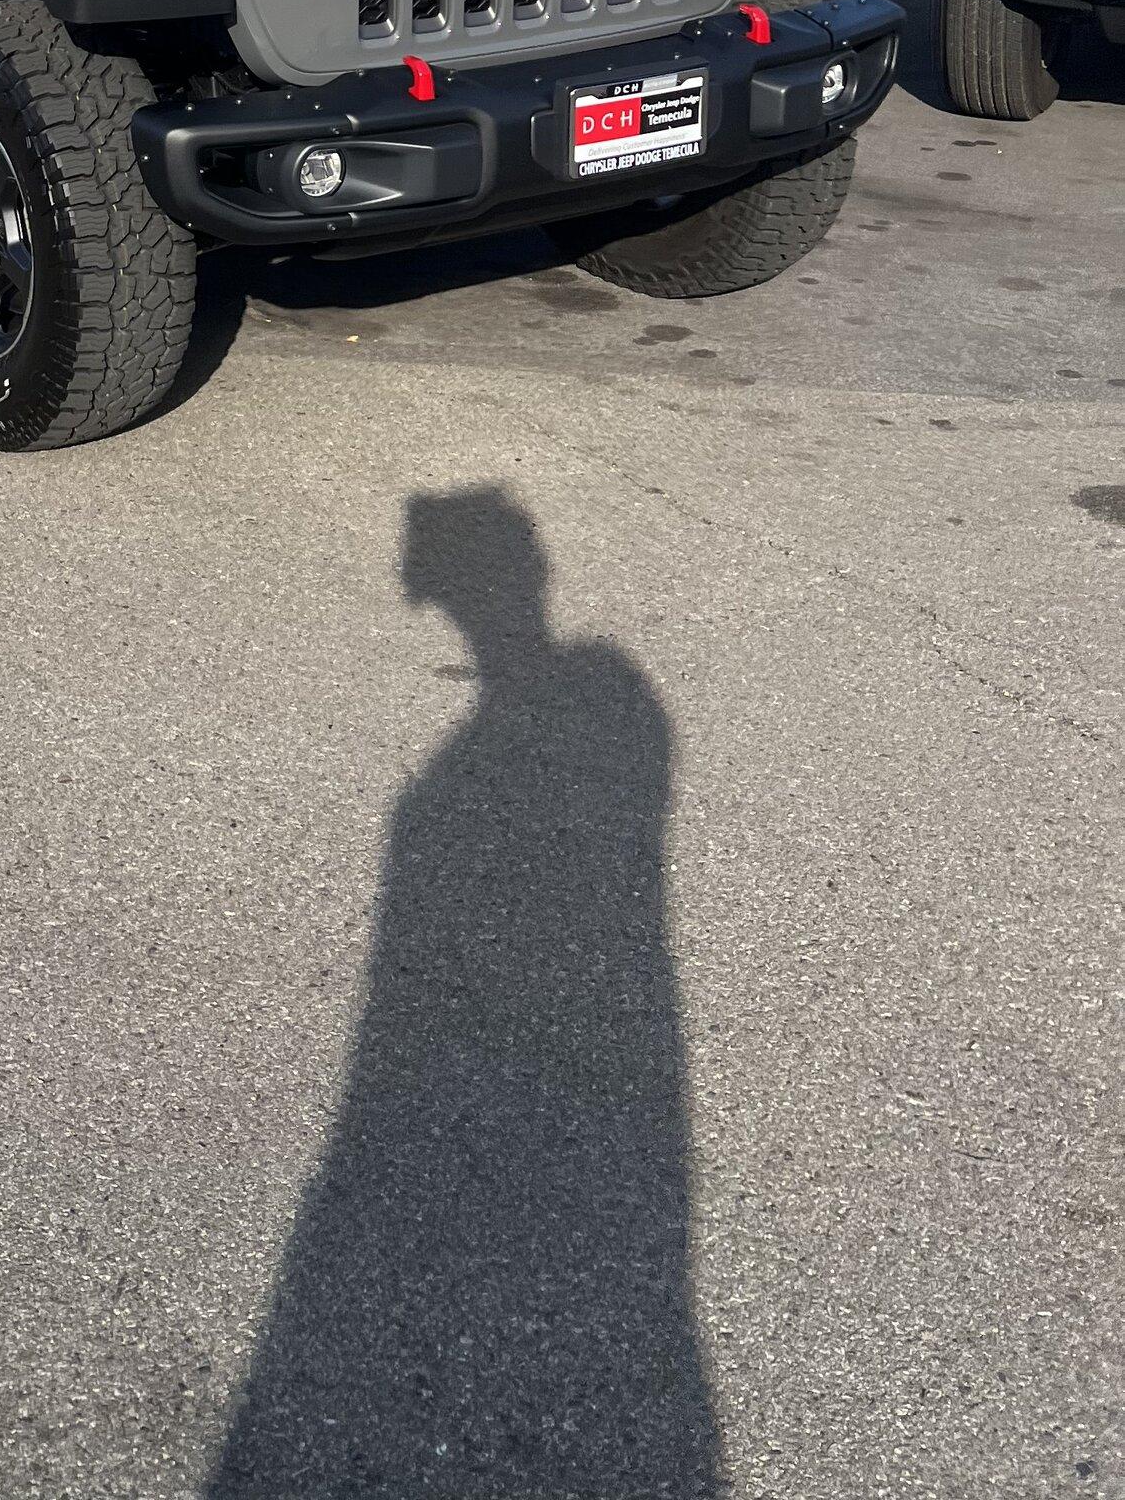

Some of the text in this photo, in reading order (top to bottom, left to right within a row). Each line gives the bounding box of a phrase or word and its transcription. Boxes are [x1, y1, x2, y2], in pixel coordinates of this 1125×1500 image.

[614, 83, 639, 95] DCH
[641, 96, 700, 112] Chrysler Jeep Dodge
[582, 109, 634, 134] DCH
[647, 107, 693, 127] Temecula
[579, 142, 700, 176] CHRYSLER JEEP DODGE TEMECULA
